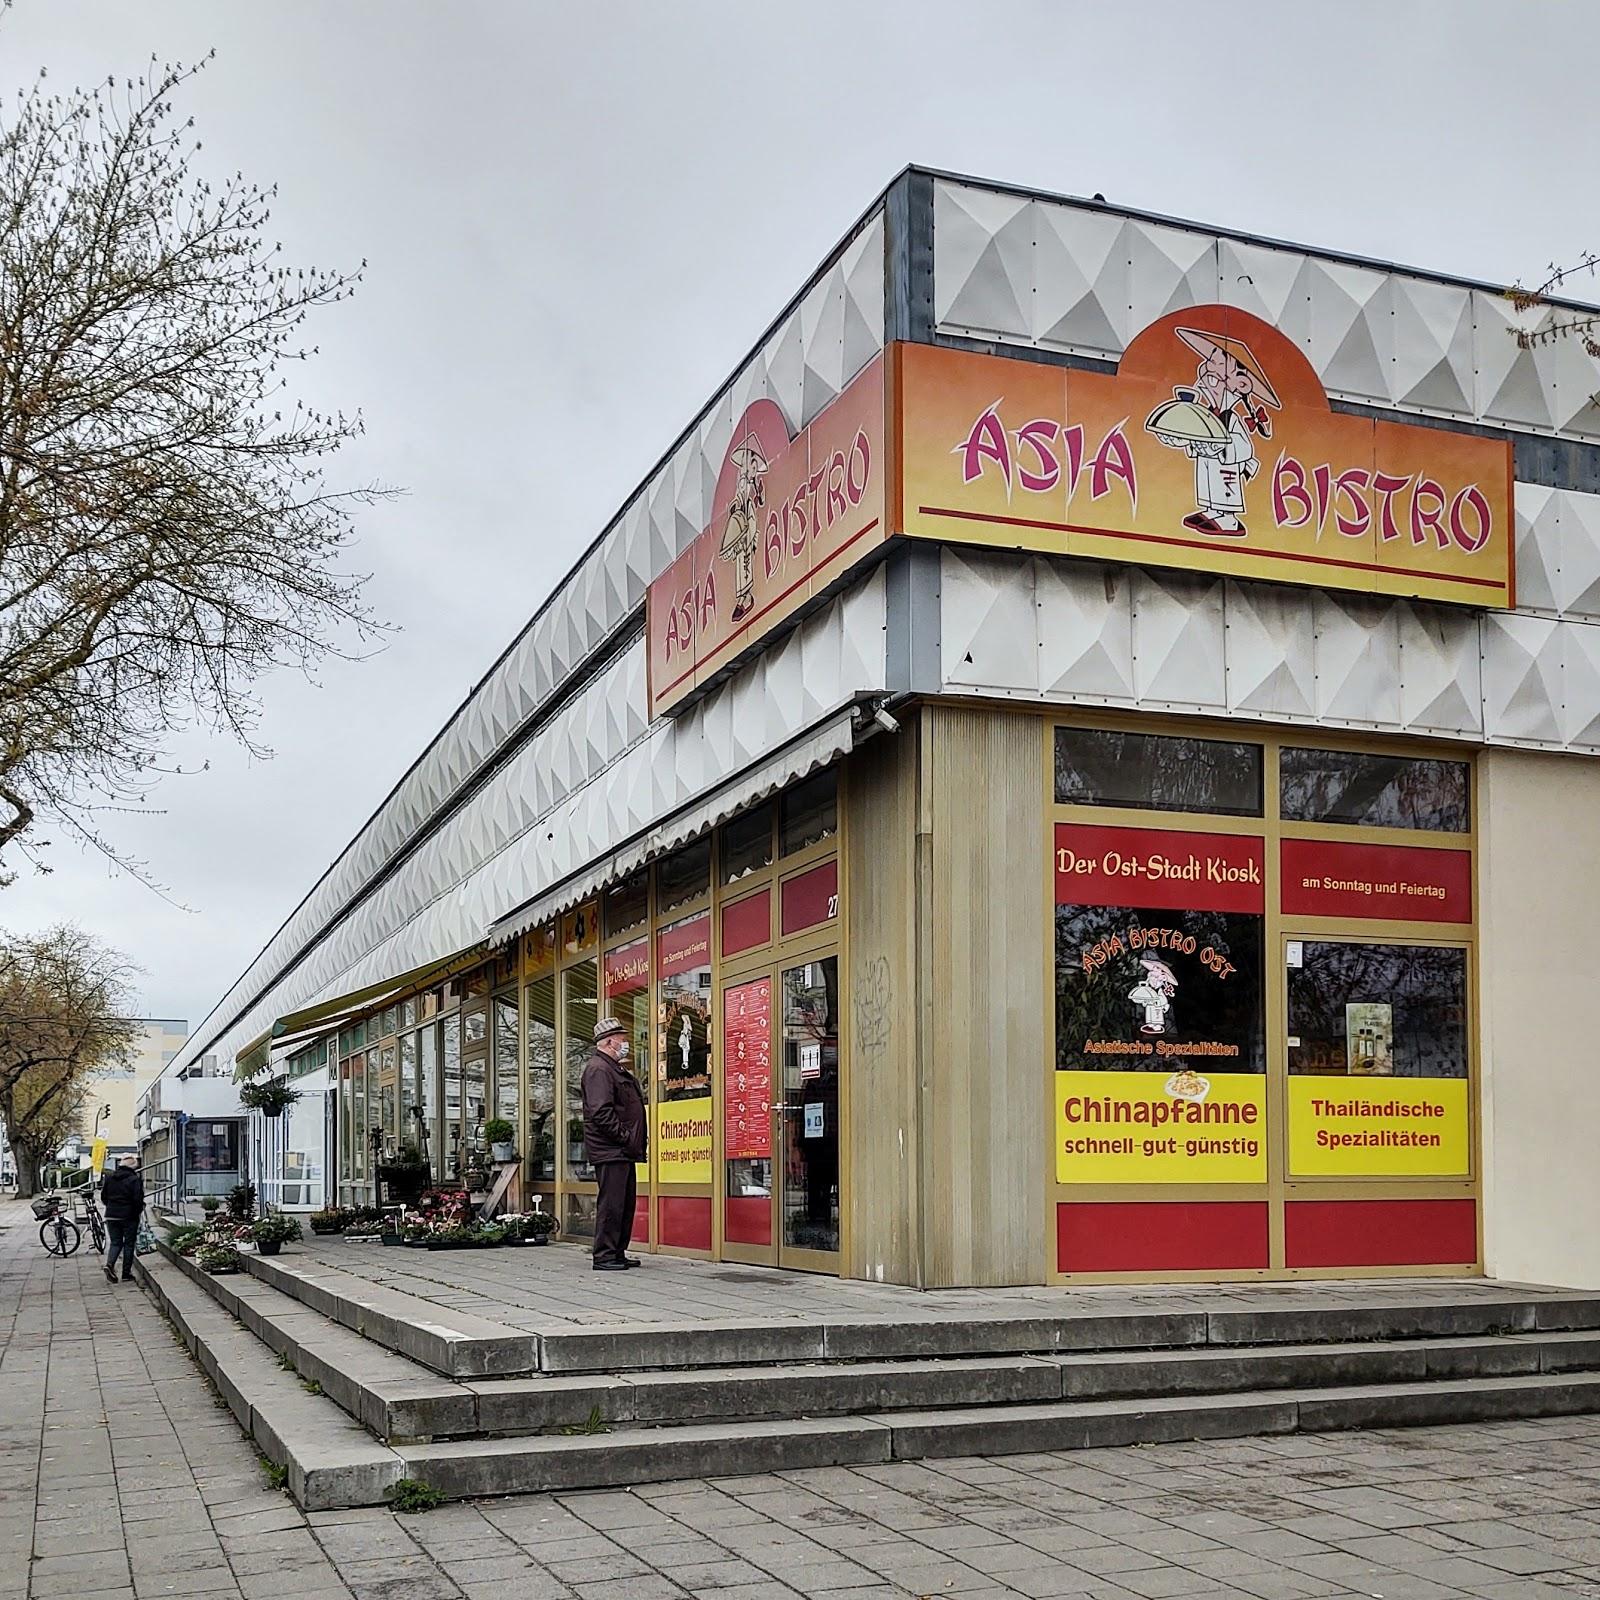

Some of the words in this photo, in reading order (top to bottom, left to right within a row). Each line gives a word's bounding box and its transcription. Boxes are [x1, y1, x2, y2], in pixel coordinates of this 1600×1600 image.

[951, 397, 1137, 519] ASIA
[1273, 448, 1493, 554] BISTRO
[665, 555, 717, 664] ASIA
[764, 425, 871, 580] BISTRO
[1057, 848, 1097, 876] Der
[1102, 851, 1201, 881] Ost-Stadt
[1207, 857, 1261, 885] Kiosk
[1302, 878, 1320, 889] am
[1323, 877, 1372, 896] Sonntag
[1375, 881, 1397, 895] und
[1400, 882, 1446, 900] Feiertag
[828, 895, 838, 919] 27
[669, 949, 684, 962] Sonntag
[691, 941, 707, 952] Feiertag
[1082, 932, 1125, 976] ASIA
[1129, 928, 1196, 955] BISTRO
[1199, 945, 1238, 980] OST
[605, 970, 614, 987] Der
[1084, 1040, 1153, 1055] Asiatische
[1155, 1039, 1239, 1057] Spezialitäten
[1064, 1097, 1258, 1128] Chinapfanne
[1311, 1100, 1445, 1118] Thailändische
[1065, 1137, 1259, 1157] schnell-gut-günstig
[1316, 1130, 1441, 1150] Spezialitäten
